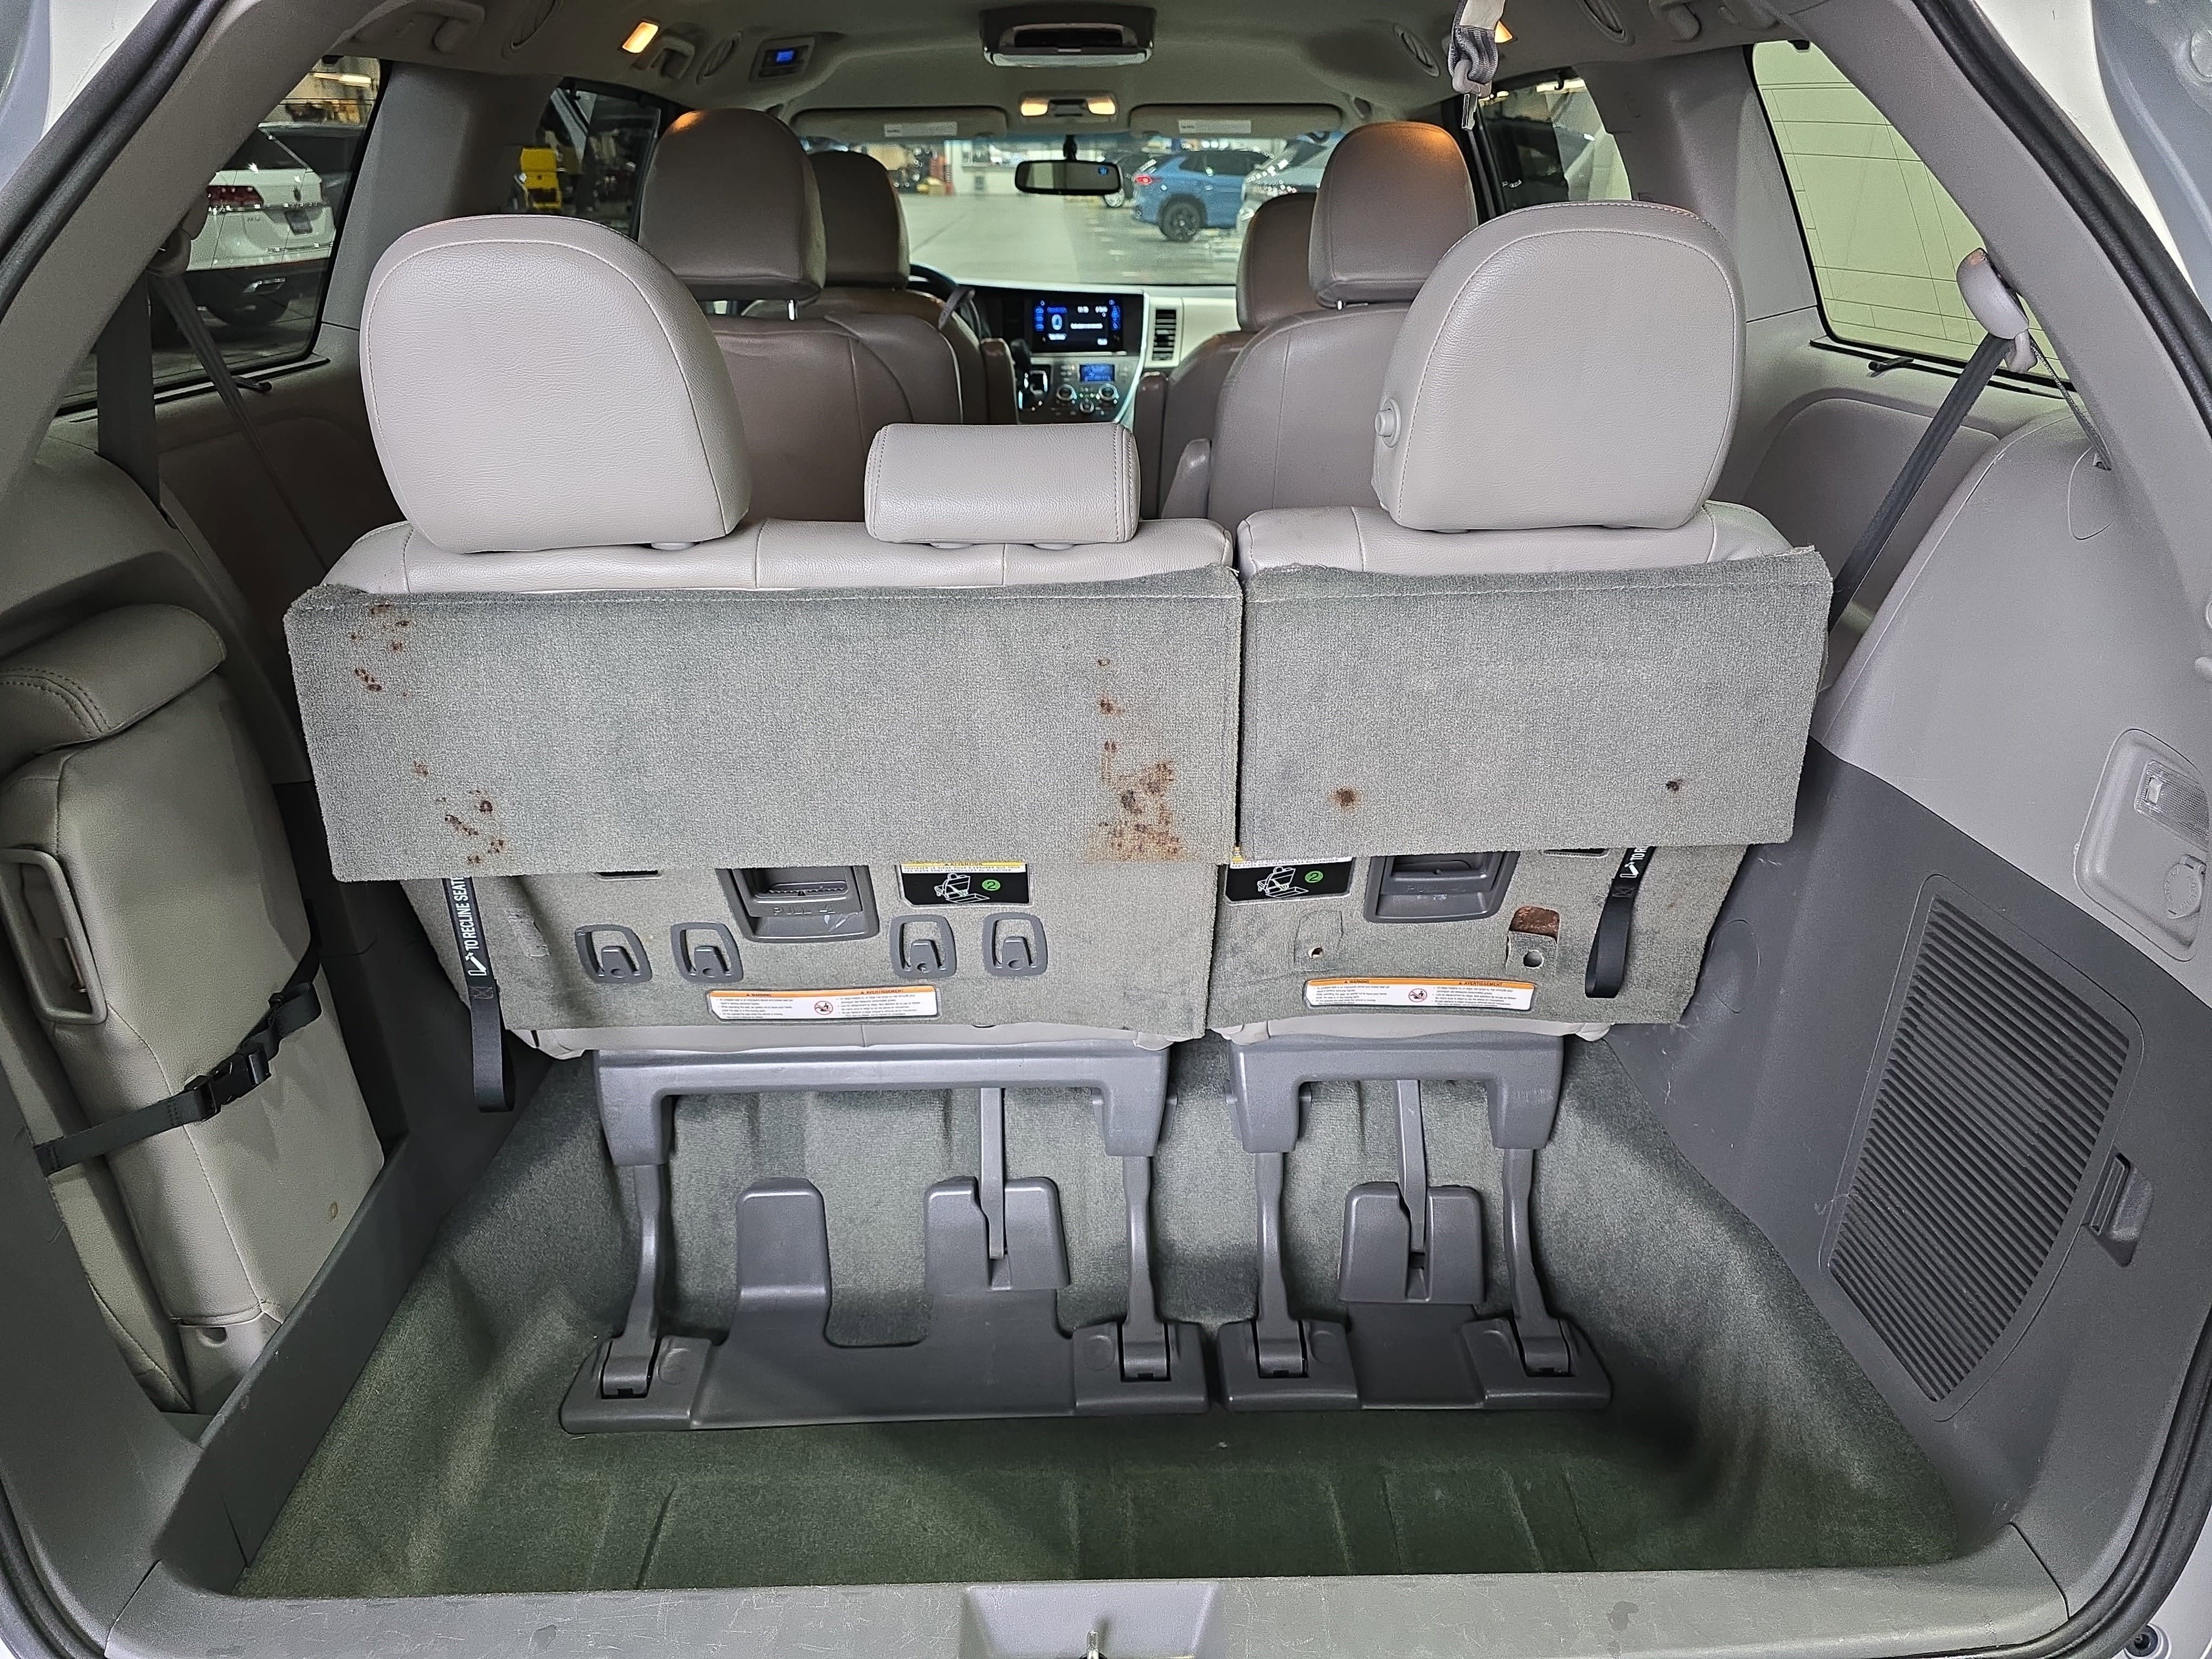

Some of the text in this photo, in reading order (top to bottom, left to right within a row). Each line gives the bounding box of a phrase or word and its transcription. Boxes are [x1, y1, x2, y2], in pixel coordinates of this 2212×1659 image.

[1309, 872, 1320, 882] 2
[986, 880, 996, 890] 2
[451, 879, 468, 902] SEAT
[773, 906, 812, 916] PULL
[455, 903, 477, 938] RECLINE
[464, 940, 480, 951] TO
